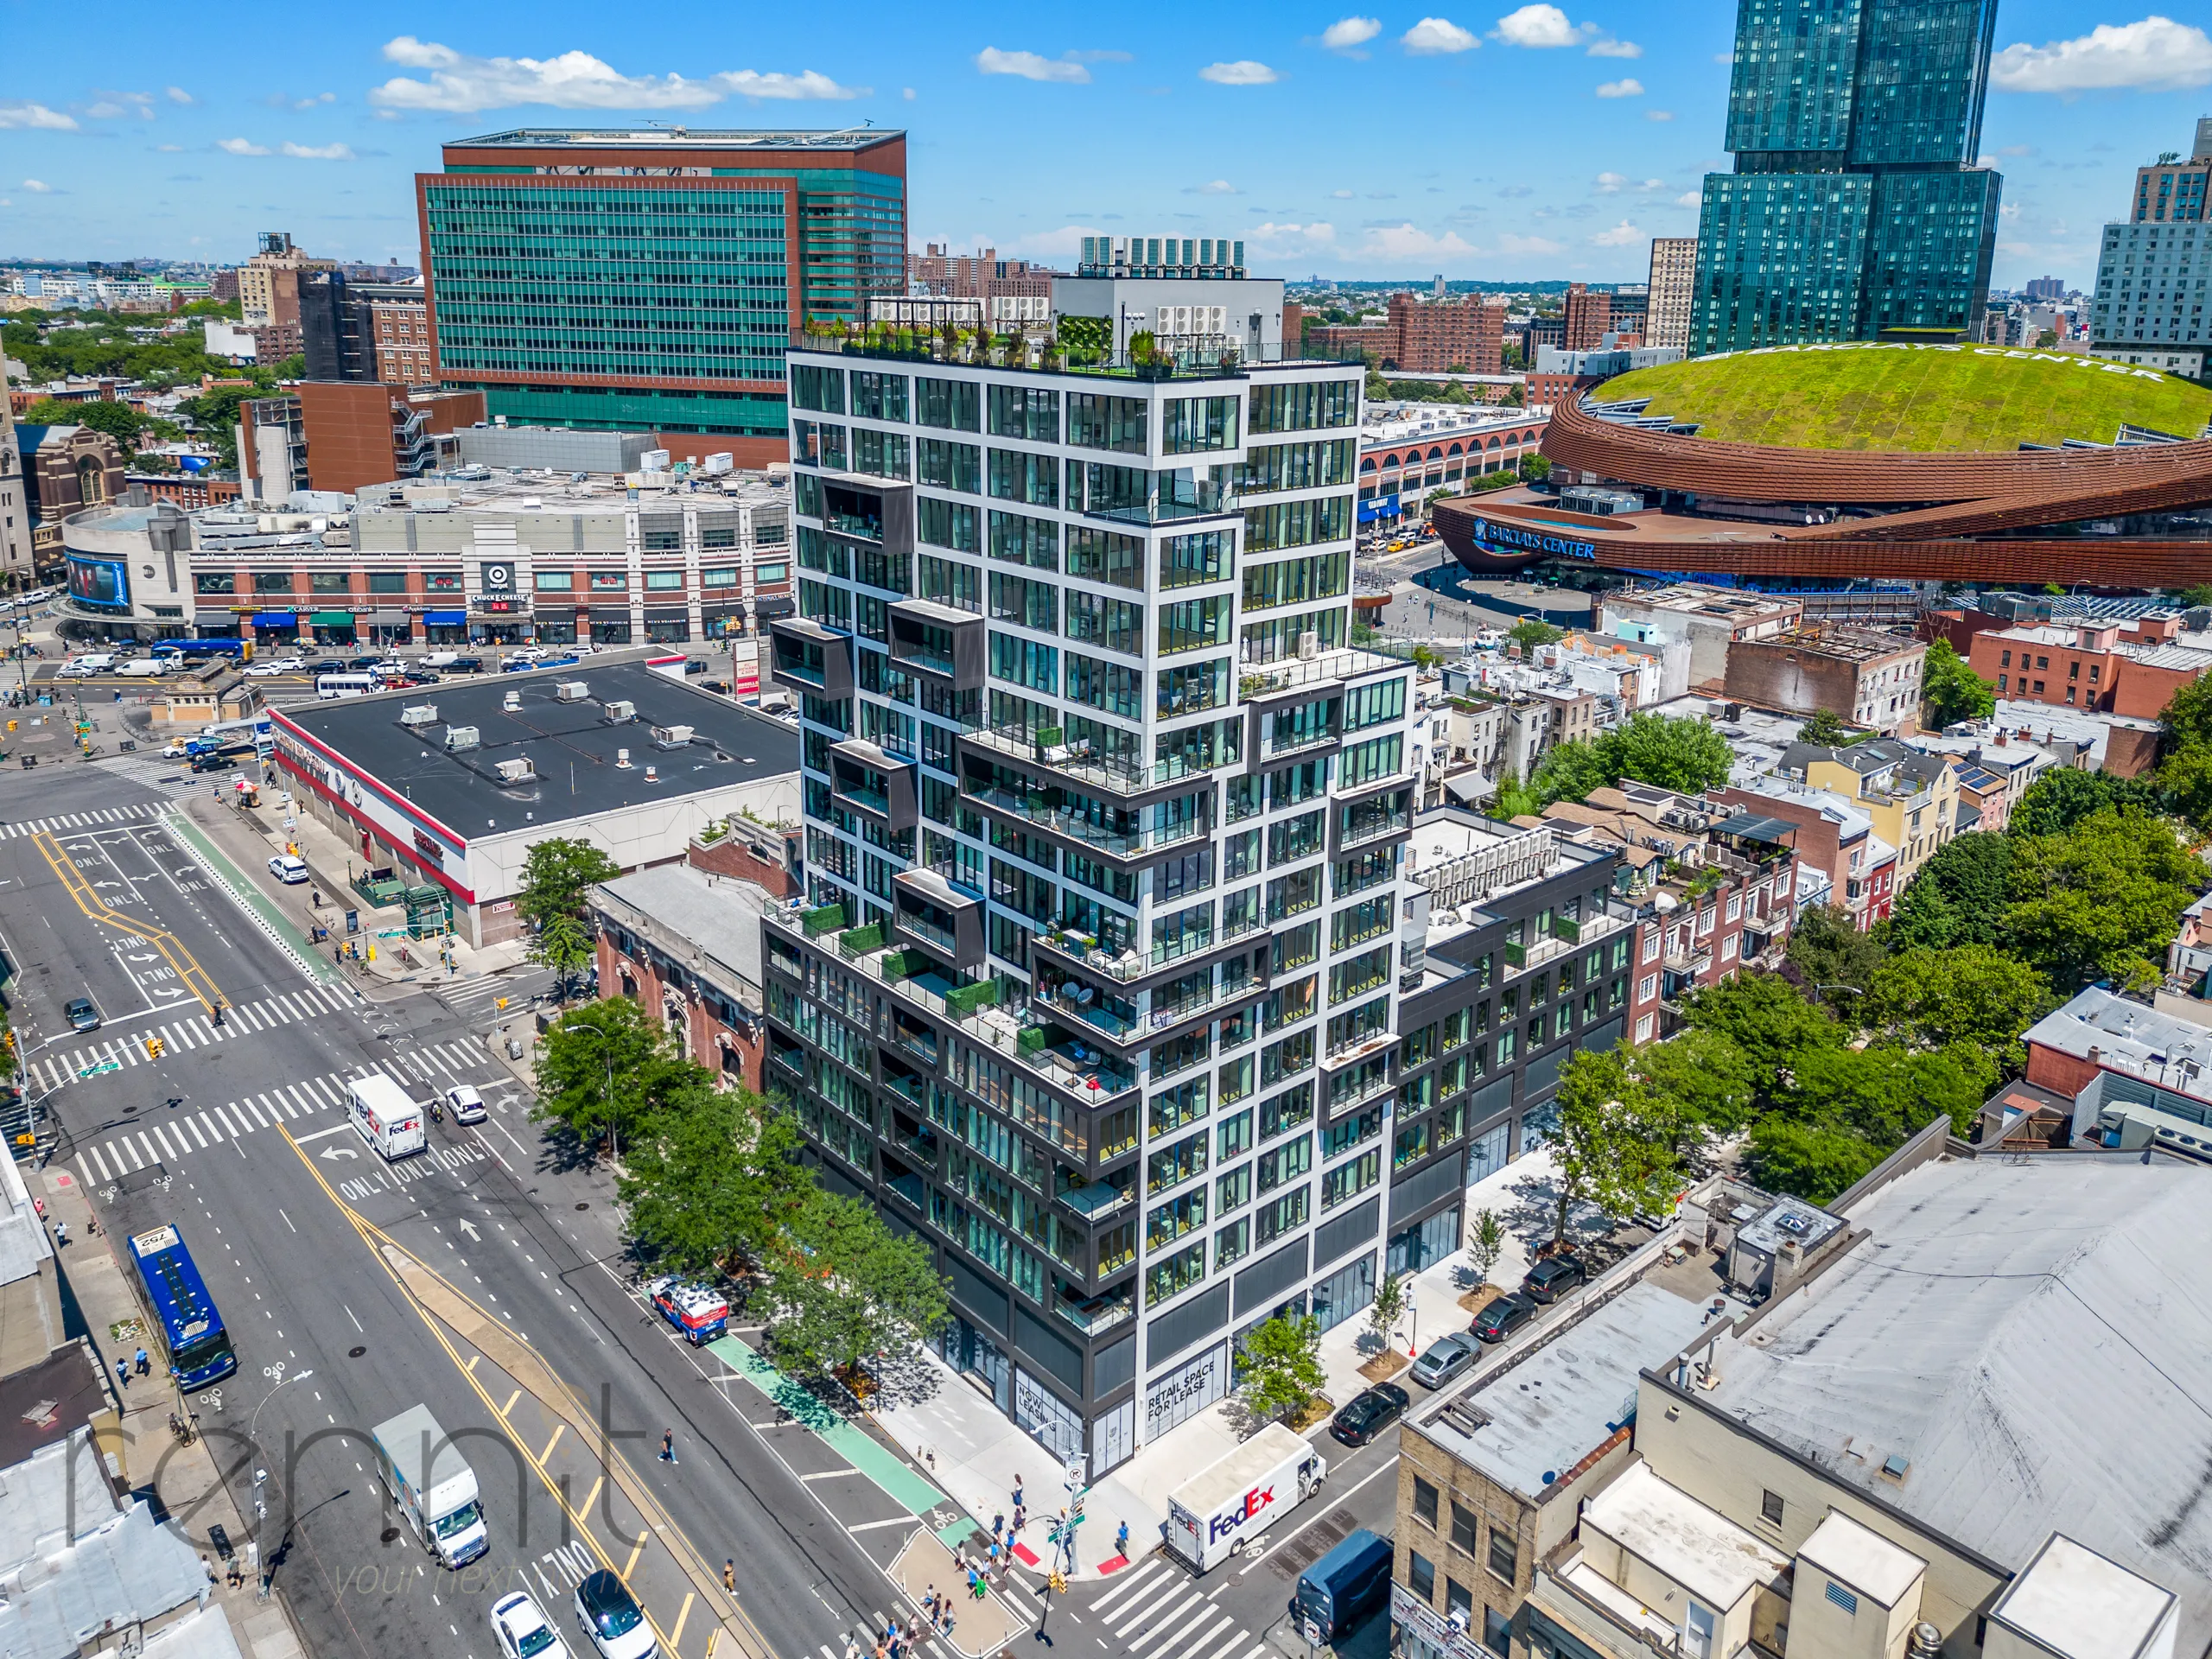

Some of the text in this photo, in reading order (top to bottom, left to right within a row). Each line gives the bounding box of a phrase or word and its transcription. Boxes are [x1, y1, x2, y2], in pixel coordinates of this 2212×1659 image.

[1489, 524, 1596, 559] BARCLAYS CENTER
[74, 855, 110, 868] ONLY
[147, 842, 181, 855] ONLY
[104, 892, 140, 907] ONLY
[180, 878, 215, 893] ONLY
[112, 935, 148, 952] ONLY
[137, 966, 176, 986] ONLY
[355, 1094, 381, 1138] FedEx
[389, 1121, 420, 1136] FedEx
[340, 1139, 491, 1201] ONLY ONLY ONLY
[142, 1233, 168, 1248] 752
[1019, 1384, 1042, 1409] NOW
[1147, 1377, 1205, 1422] FOR LEASE
[1148, 1361, 1215, 1410] RETAIL SPACE
[1019, 1395, 1056, 1432] LEASING
[1171, 1508, 1200, 1541] FedEx
[1210, 1484, 1275, 1547] FedEx
[531, 1540, 597, 1599] ONLY
